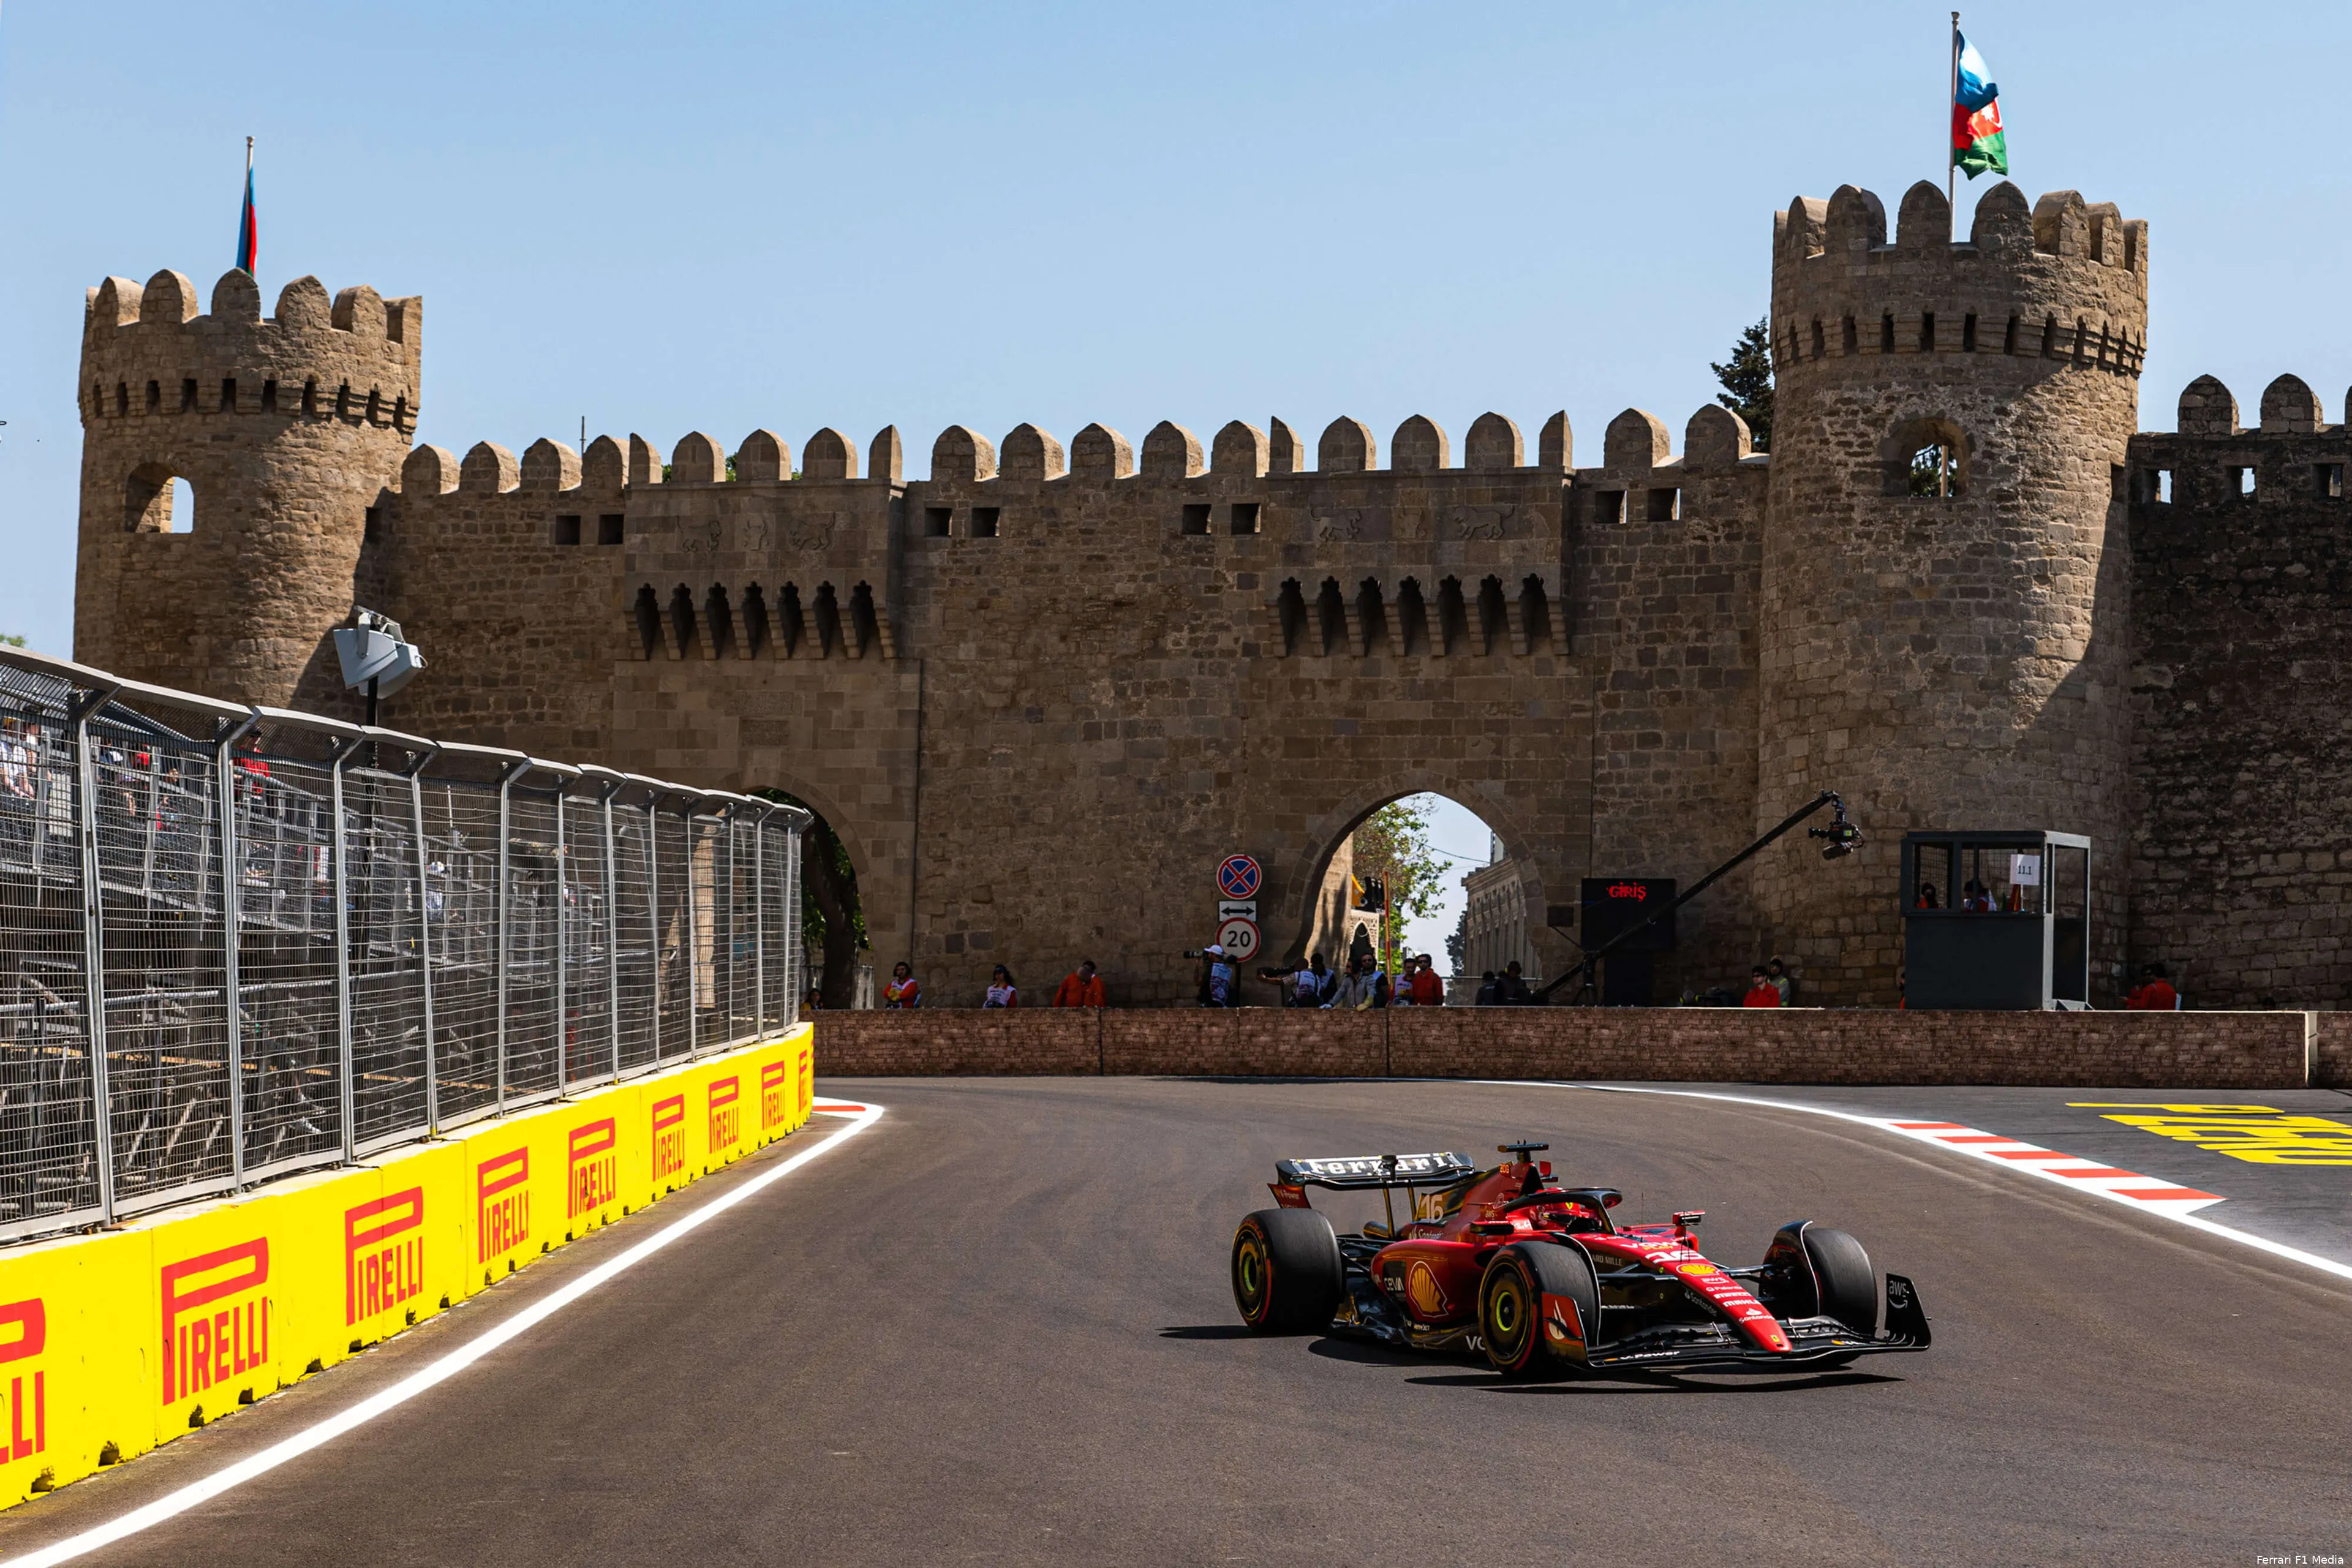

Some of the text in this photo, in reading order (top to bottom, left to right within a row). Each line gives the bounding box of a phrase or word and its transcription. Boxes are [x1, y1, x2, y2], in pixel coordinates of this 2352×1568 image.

[2017, 864, 2033, 875] 11.1
[1227, 930, 1251, 948] 20
[709, 1076, 740, 1154] PIRELLI
[762, 1060, 785, 1131] PIRELLI
[568, 1117, 617, 1220] PIRELLI
[652, 1093, 685, 1183] PIRELLI
[478, 1146, 530, 1265] PIRELLI
[1420, 1194, 1444, 1224] 16
[345, 1186, 424, 1327] PIRELLI
[161, 1236, 270, 1407] PIRELLI
